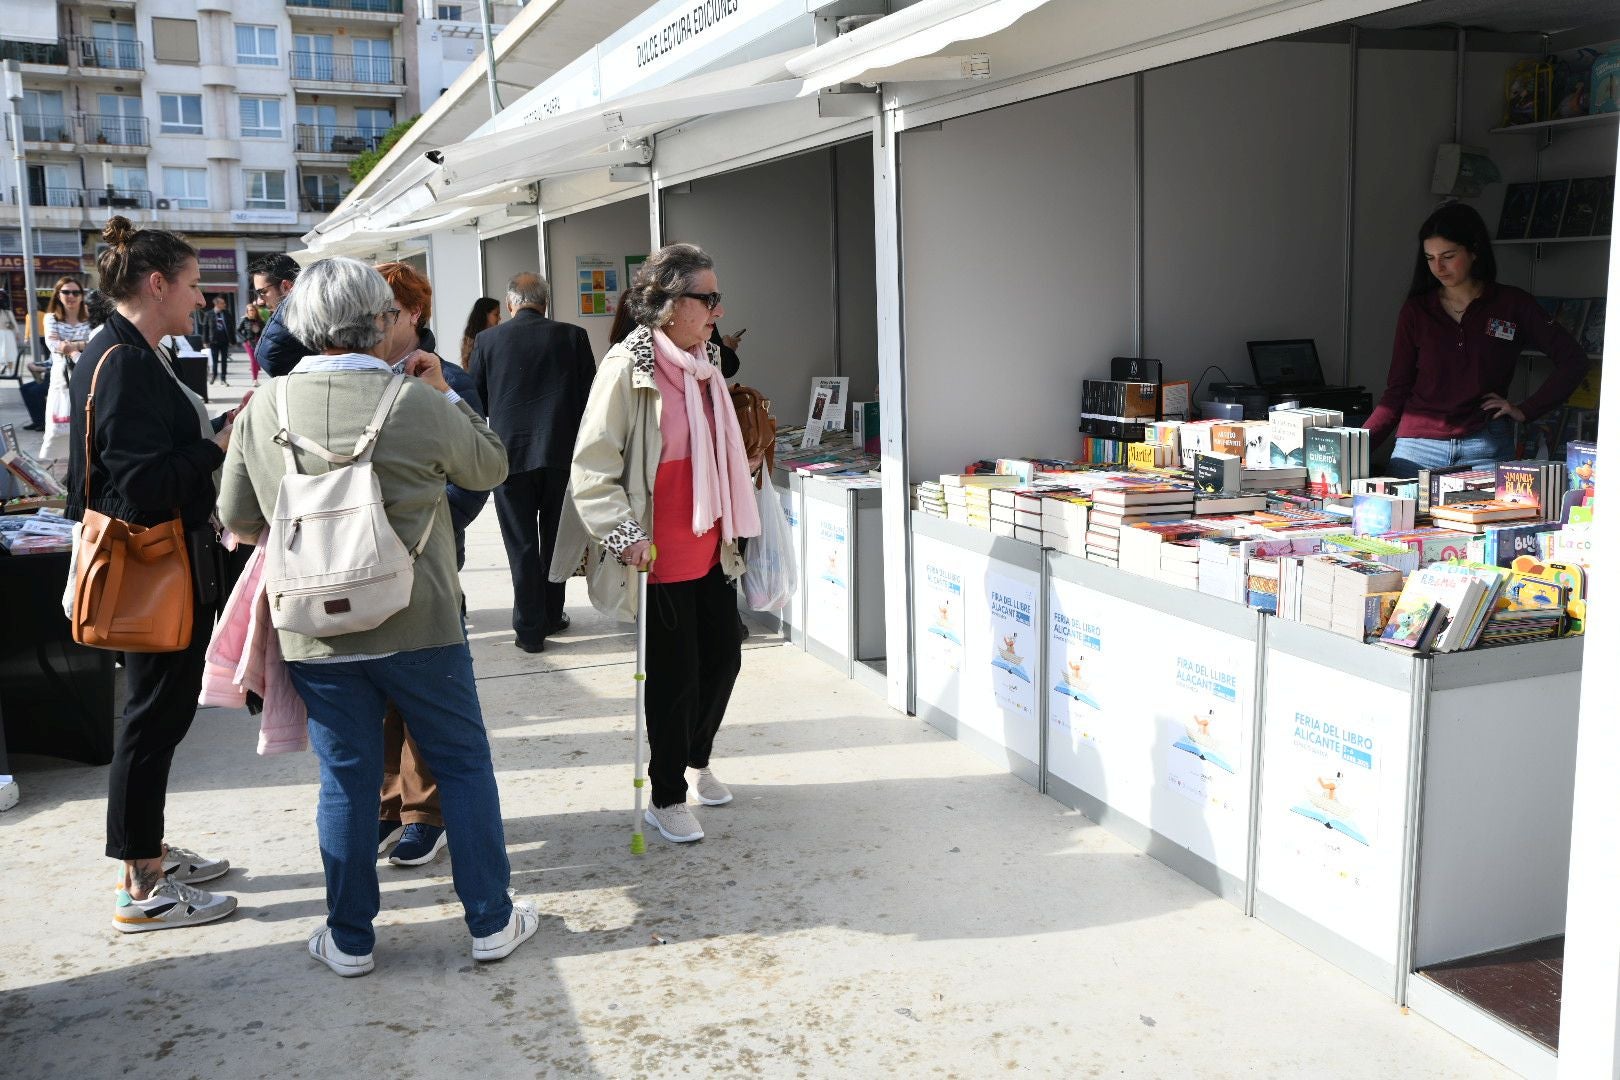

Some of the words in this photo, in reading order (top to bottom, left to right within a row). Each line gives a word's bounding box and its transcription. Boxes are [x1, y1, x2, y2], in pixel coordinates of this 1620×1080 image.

[636, 34, 659, 68] DULCE
[659, 13, 693, 55] LECTURA
[1309, 453, 1337, 464] QUERIDA
[1504, 472, 1534, 483] AMANDA
[1505, 482, 1533, 496] BLACK
[991, 601, 1015, 618] ALACANT
[1003, 595, 1013, 607] DEL
[1013, 599, 1031, 614] LLIBRE
[1053, 623, 1083, 641] ALICANTE
[1054, 612, 1071, 626] FERIA
[1071, 618, 1081, 630] DEL
[1082, 622, 1101, 636] LIBRO
[1176, 656, 1194, 672] FIRA
[1195, 663, 1209, 678] DEL
[1210, 668, 1237, 687] LLIBRE
[1176, 669, 1213, 691] ALACANT
[1294, 711, 1321, 732] FERIA
[1322, 722, 1340, 738] DEL
[1342, 729, 1373, 750] LIBRO
[1294, 726, 1341, 753] ALICANTE
